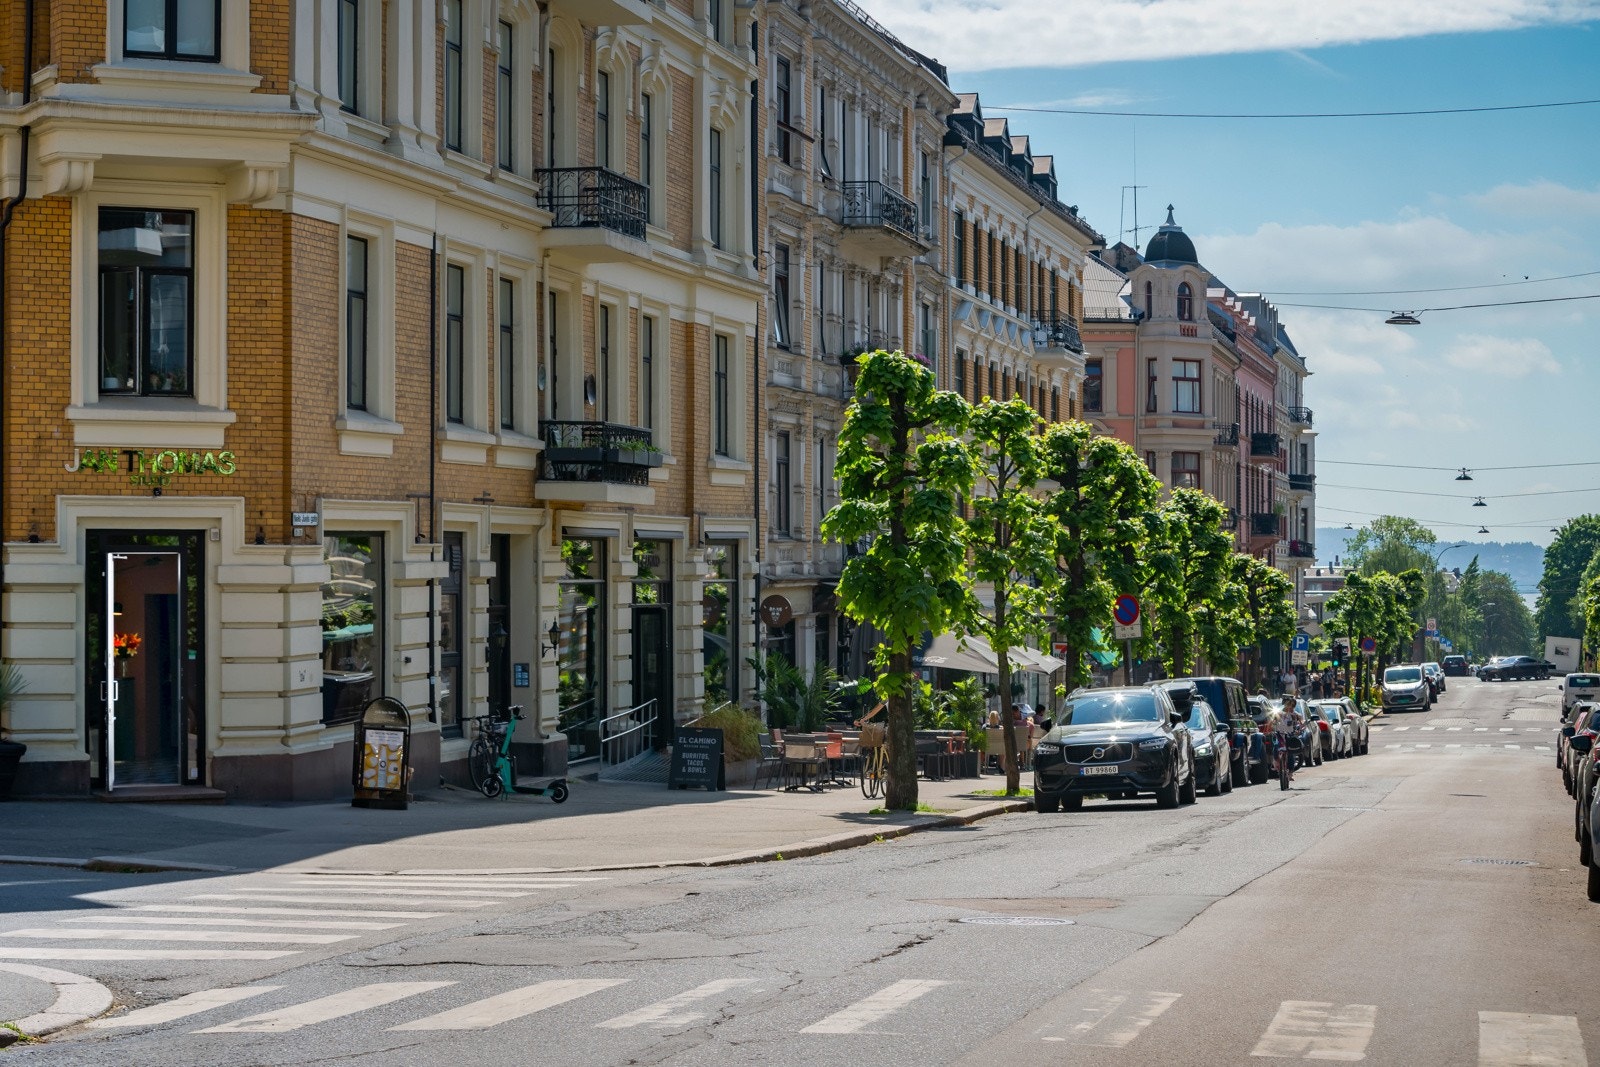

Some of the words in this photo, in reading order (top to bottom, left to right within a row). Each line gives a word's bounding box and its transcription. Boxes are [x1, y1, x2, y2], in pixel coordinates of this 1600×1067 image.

[64, 448, 118, 473] JAN
[123, 450, 236, 474] THOMAS
[1296, 636, 1305, 648] P
